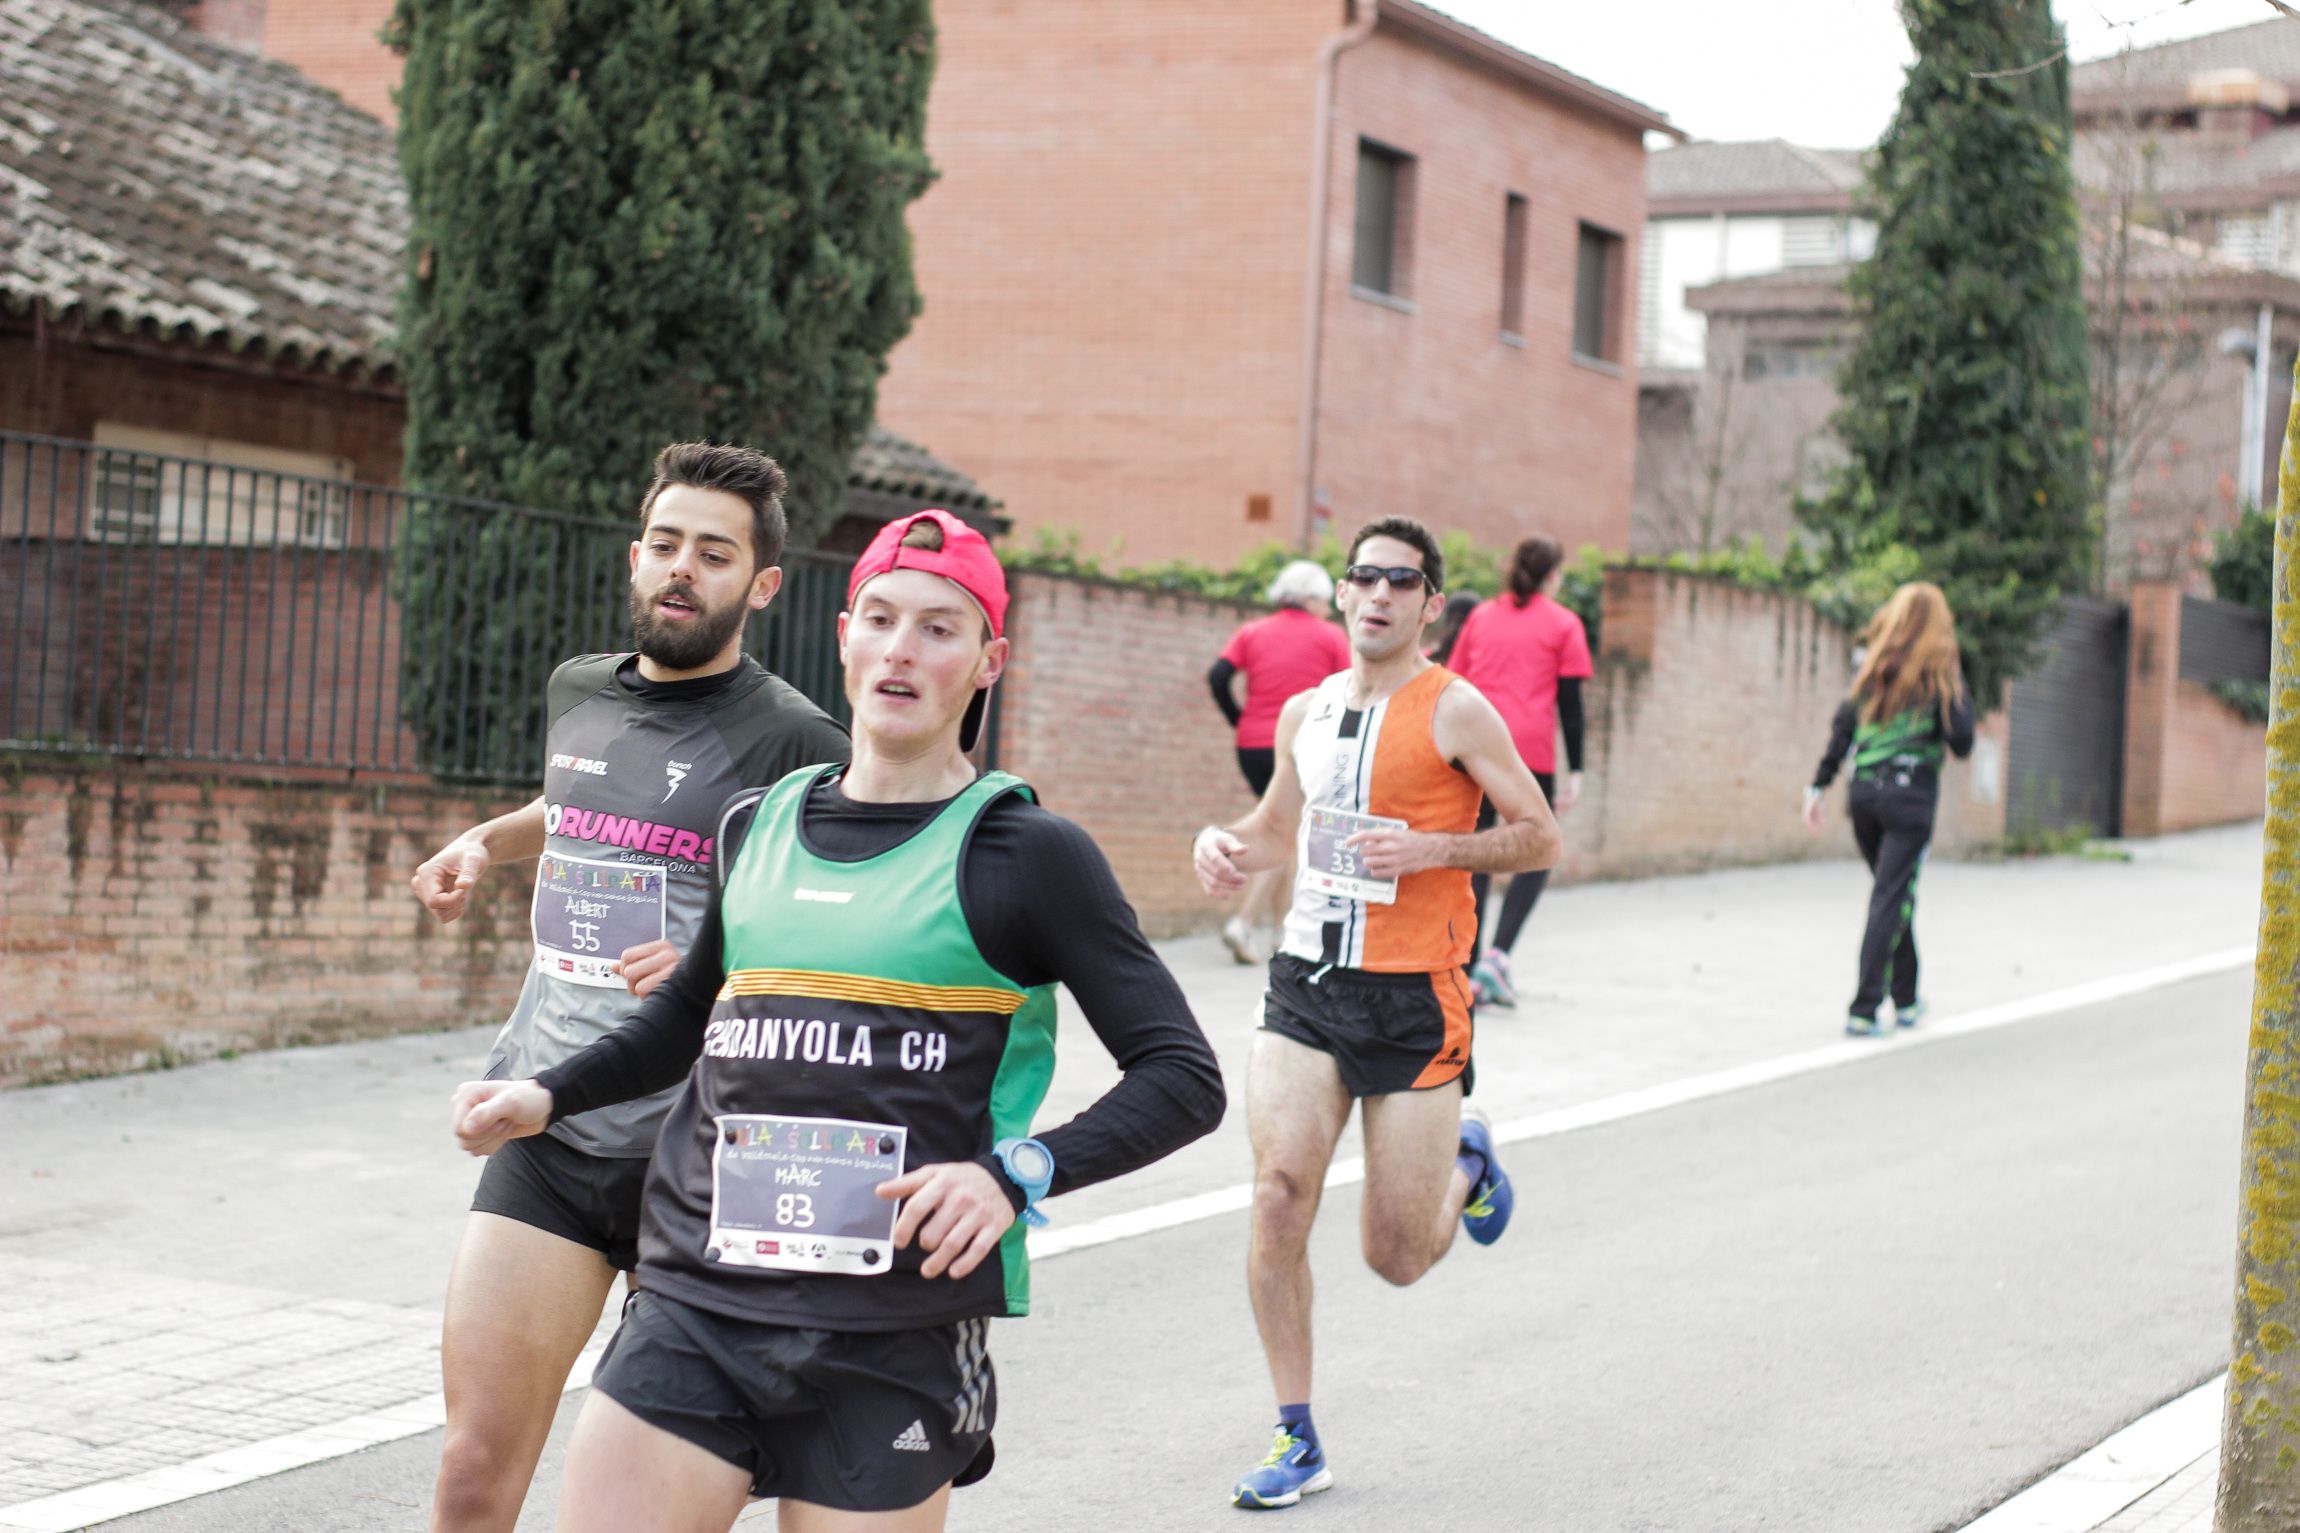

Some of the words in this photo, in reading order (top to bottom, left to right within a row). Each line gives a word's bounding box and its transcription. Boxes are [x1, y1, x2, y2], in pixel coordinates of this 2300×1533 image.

[1330, 852, 1356, 875] 33
[565, 895, 612, 918] ALBERT
[569, 919, 601, 951] 55
[900, 1031, 947, 1072] CH
[775, 1164, 822, 1187] MARC
[775, 1193, 816, 1228] 83
[893, 1439, 931, 1451] adidas
